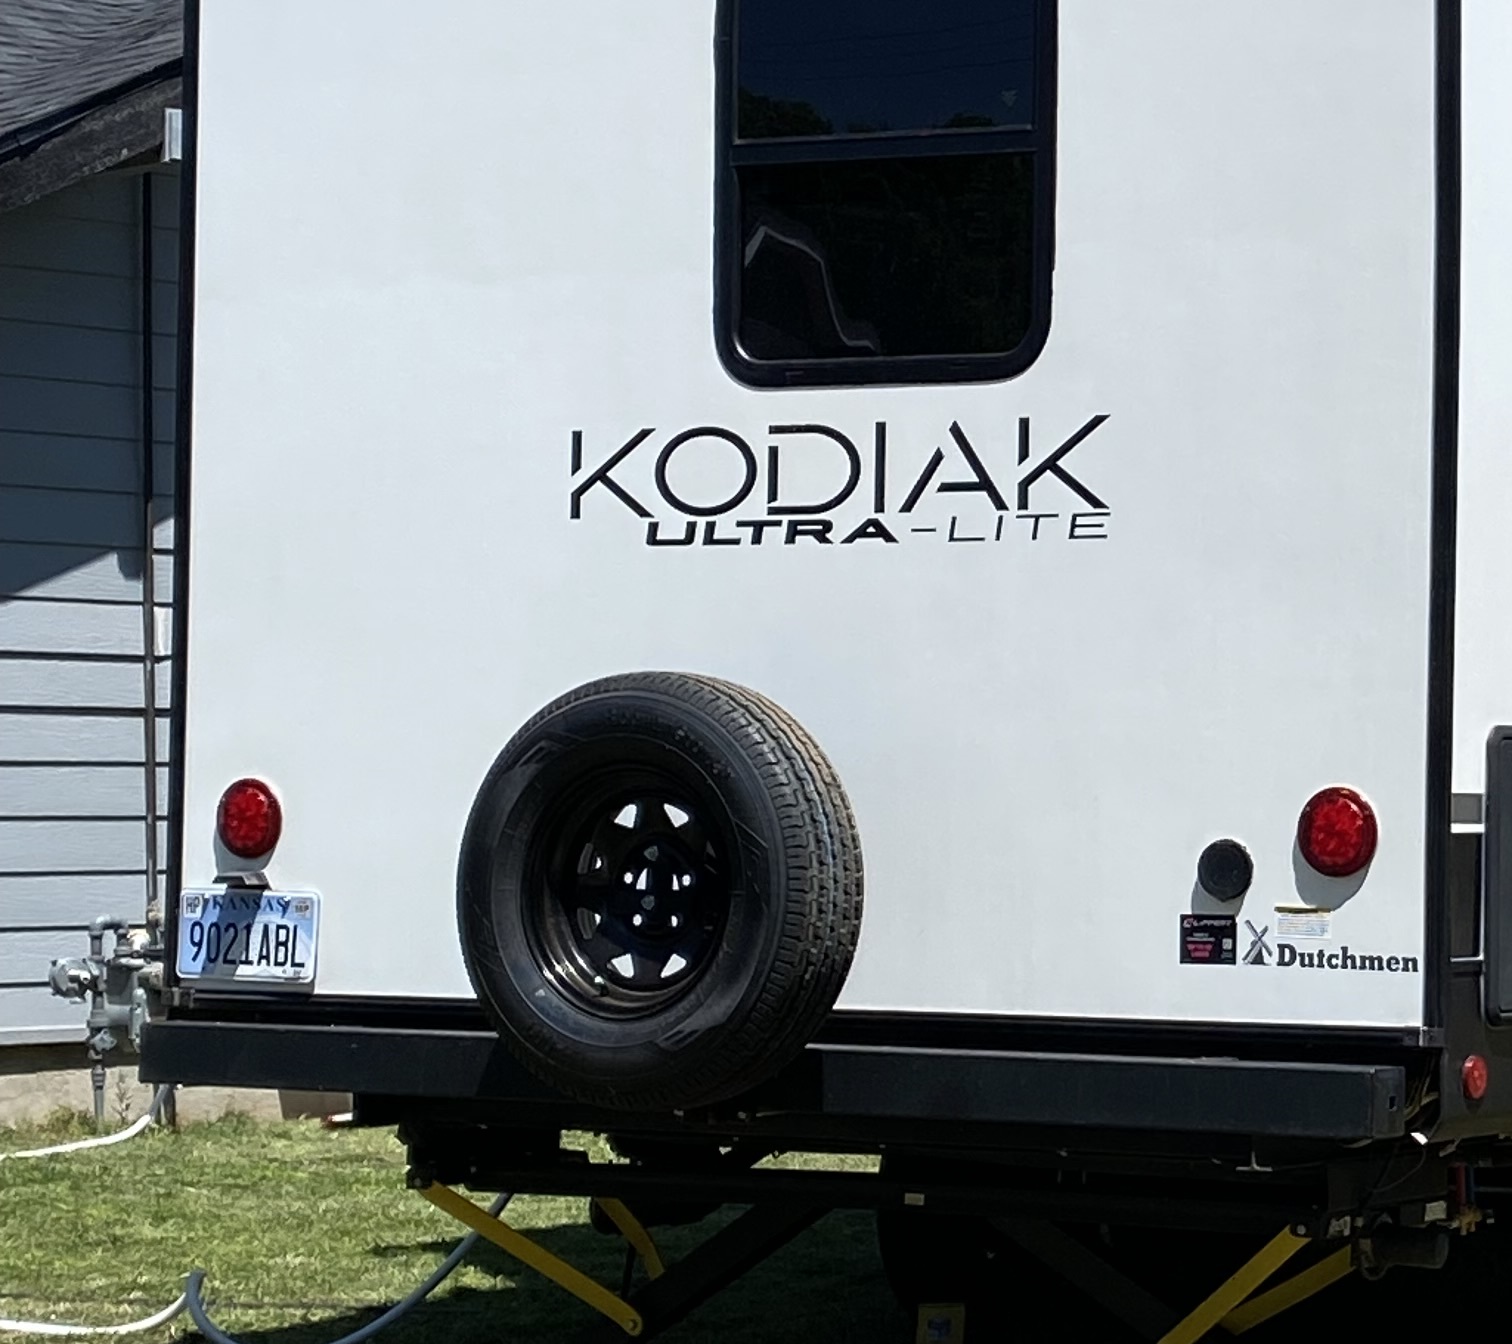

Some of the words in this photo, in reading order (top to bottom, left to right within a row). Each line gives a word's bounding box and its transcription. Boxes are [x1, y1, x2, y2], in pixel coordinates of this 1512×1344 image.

[569, 413, 1111, 520] KODIAK
[646, 512, 1111, 546] ULTRA-LITE
[212, 896, 288, 912] KANSAS
[189, 920, 305, 969] 9021ABL
[1276, 943, 1419, 973] Dutchmen
